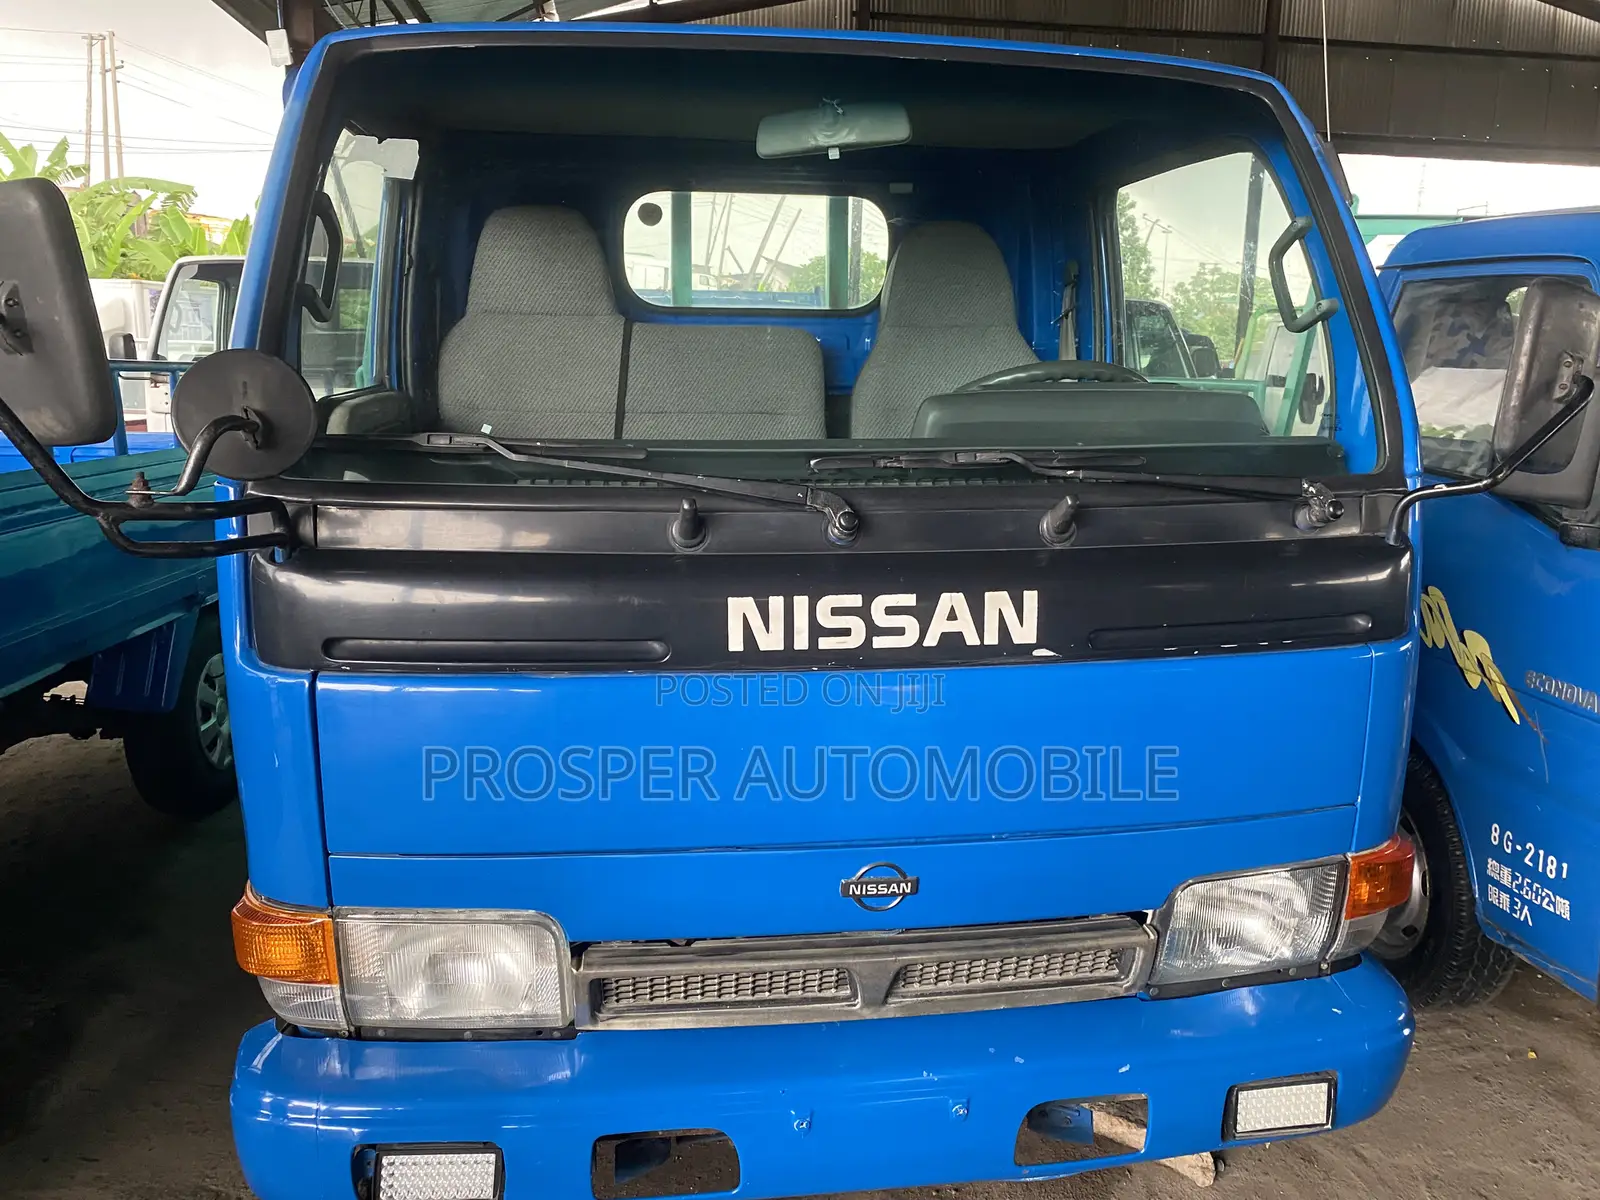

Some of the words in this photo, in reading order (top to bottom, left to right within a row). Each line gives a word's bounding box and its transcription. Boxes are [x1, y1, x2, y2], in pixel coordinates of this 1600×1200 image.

[726, 590, 1039, 652] NISSAN
[1525, 669, 1600, 714] ECONOVA
[1490, 823, 1568, 879] 8G-2181
[848, 882, 912, 896] NISSAN
